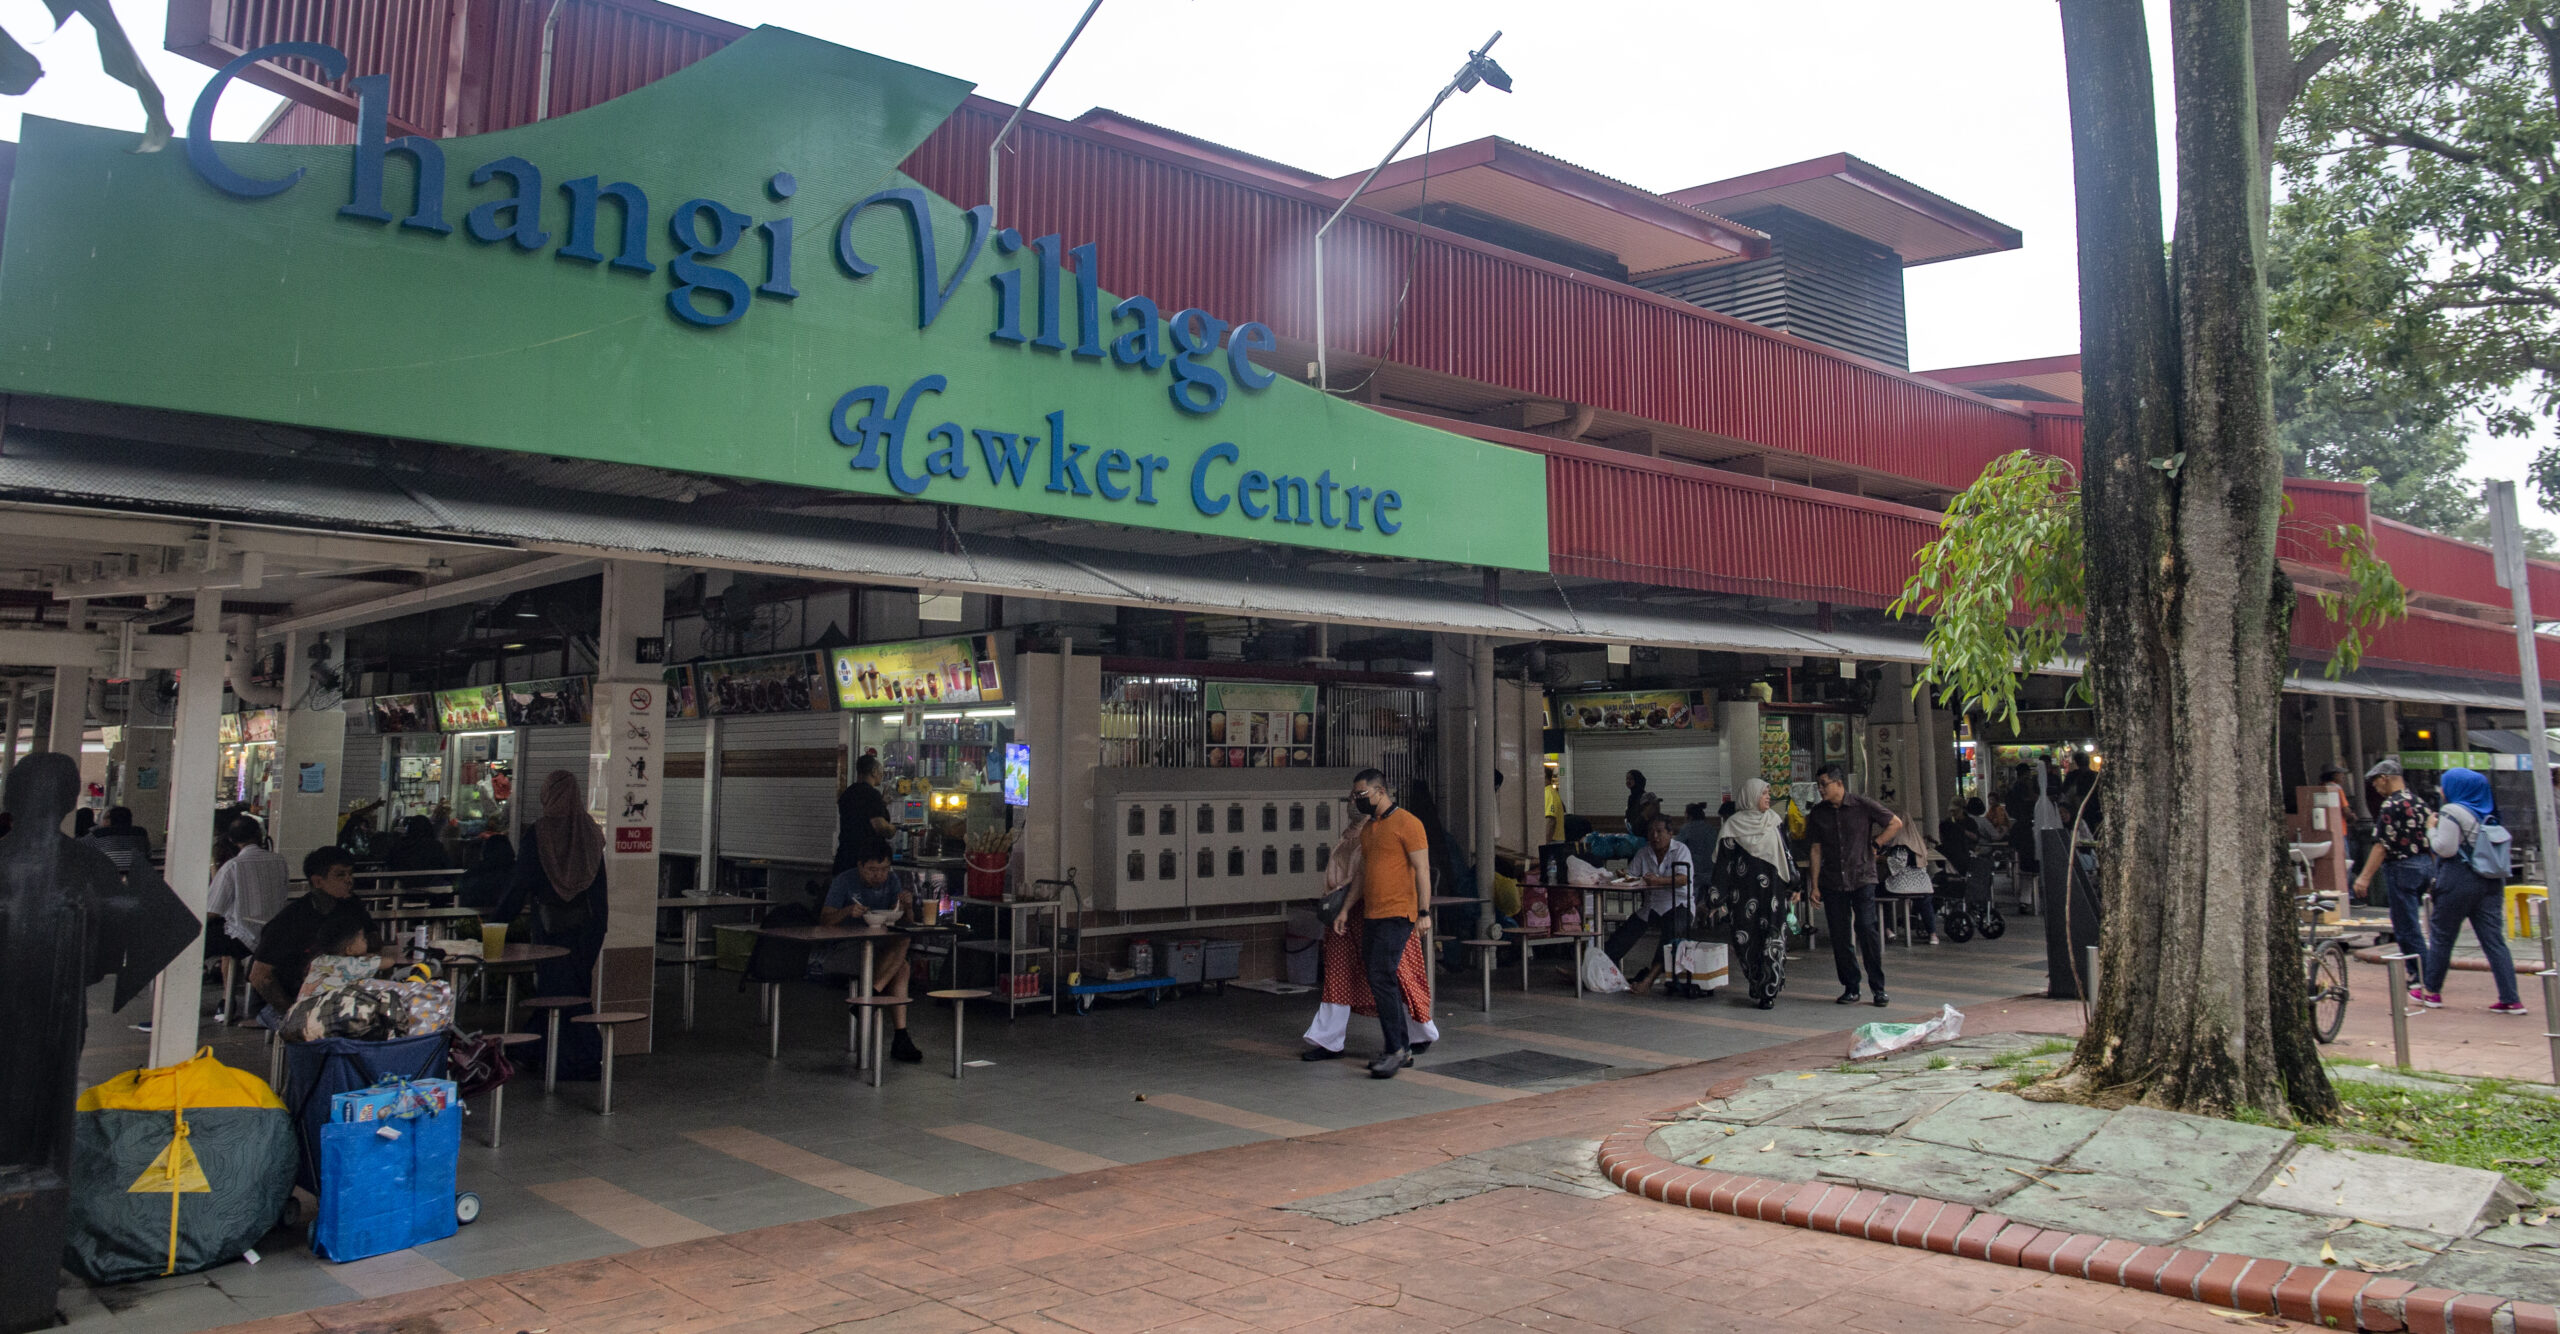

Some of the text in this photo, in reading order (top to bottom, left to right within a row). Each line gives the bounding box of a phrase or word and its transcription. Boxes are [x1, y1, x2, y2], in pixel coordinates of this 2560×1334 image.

[186, 41, 1278, 414] Changi Village
[830, 374, 1403, 535] Hawker Centre
[2404, 756, 2434, 765] HALAL
[628, 830, 641, 839] NO
[616, 841, 652, 850] TOUTING
